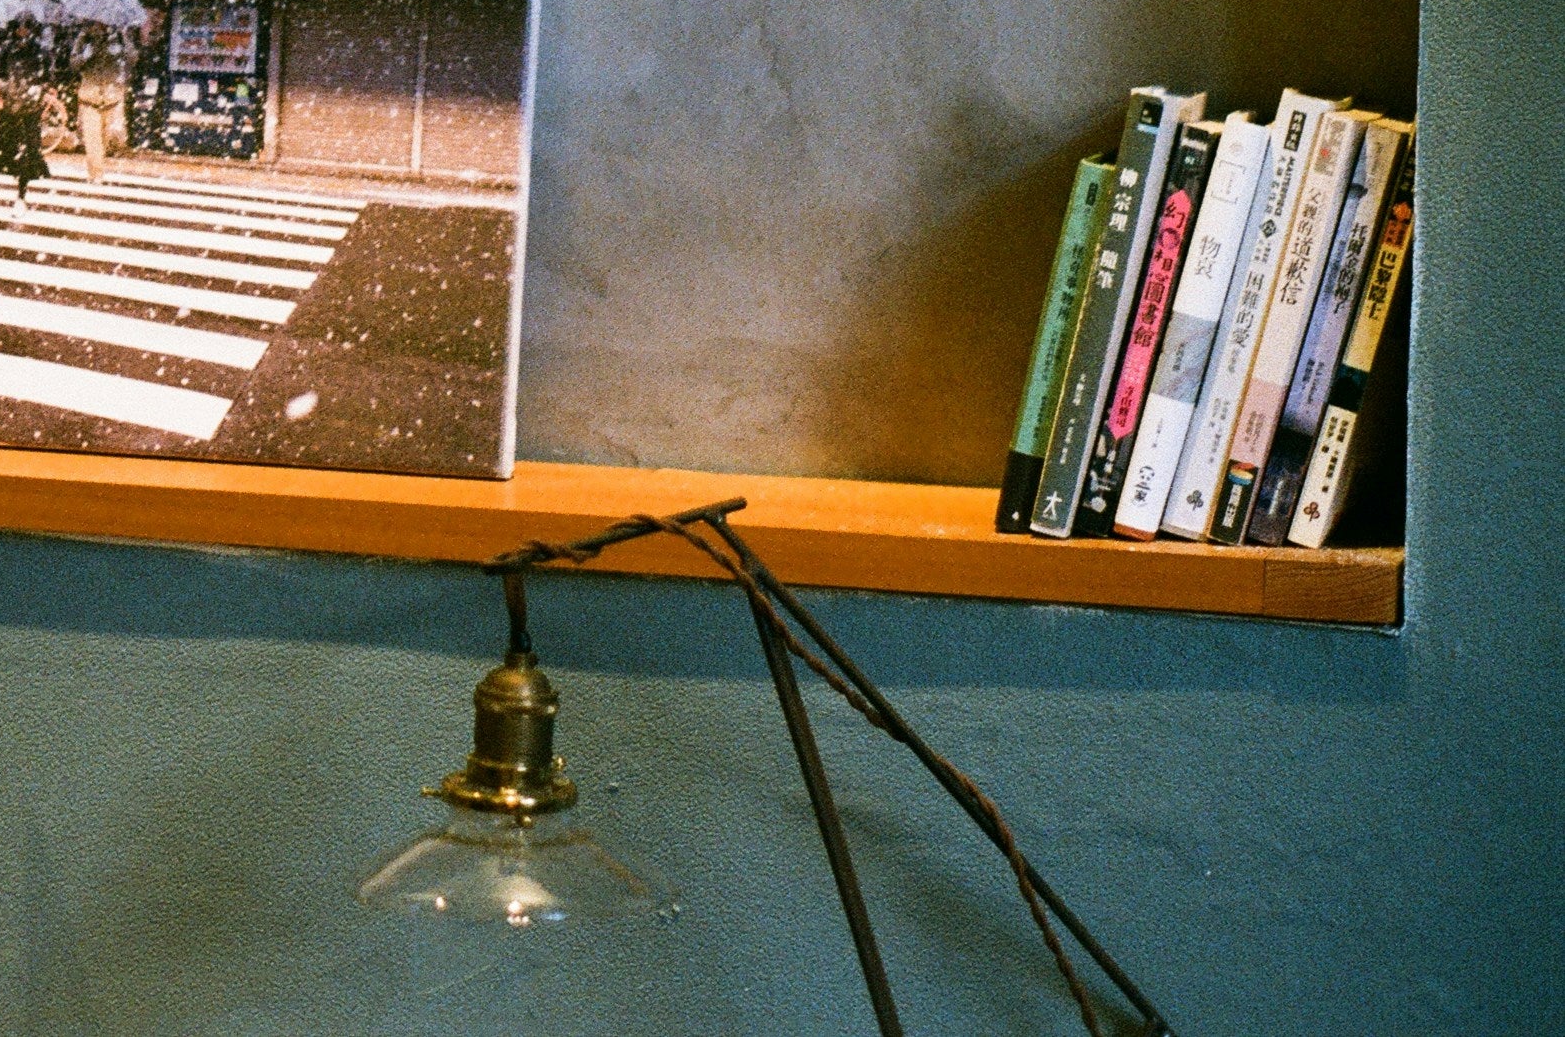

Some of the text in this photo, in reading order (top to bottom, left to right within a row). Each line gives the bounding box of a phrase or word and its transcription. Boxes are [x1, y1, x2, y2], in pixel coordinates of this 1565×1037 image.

[1108, 168, 1139, 233] 柳宗理
[1194, 234, 1222, 282] 物哀
[1279, 186, 1321, 306] 父親的道歉信
[1230, 270, 1265, 350] 困難的愛
[1363, 250, 1400, 322] 巴黎隱士
